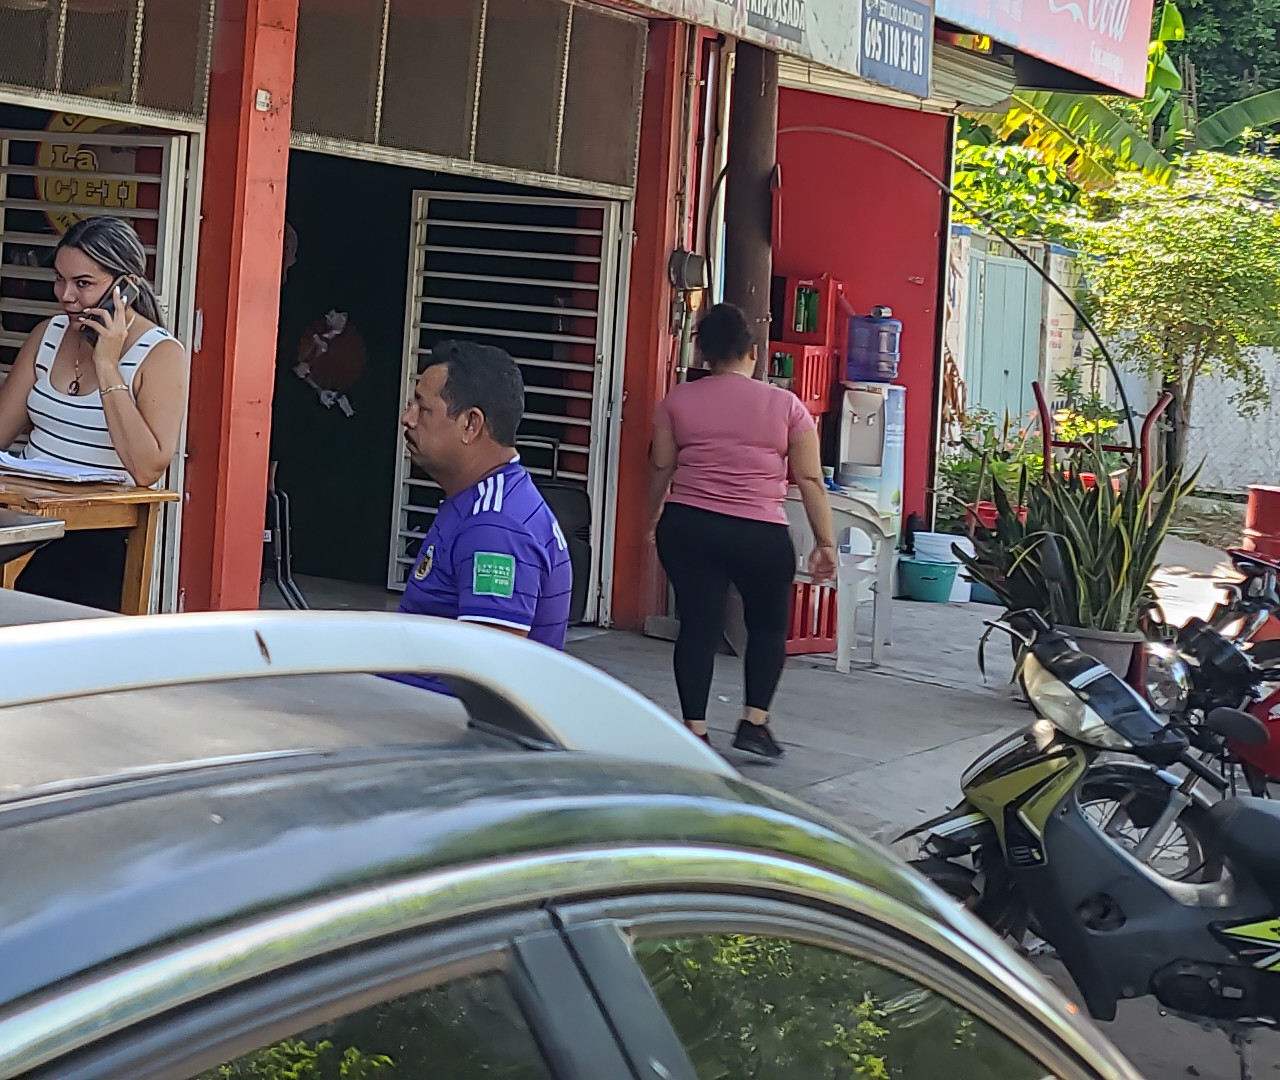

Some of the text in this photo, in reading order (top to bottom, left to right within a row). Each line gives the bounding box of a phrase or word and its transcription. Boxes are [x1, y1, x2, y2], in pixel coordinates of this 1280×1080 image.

[865, 16, 924, 76] 695 110 31 31
